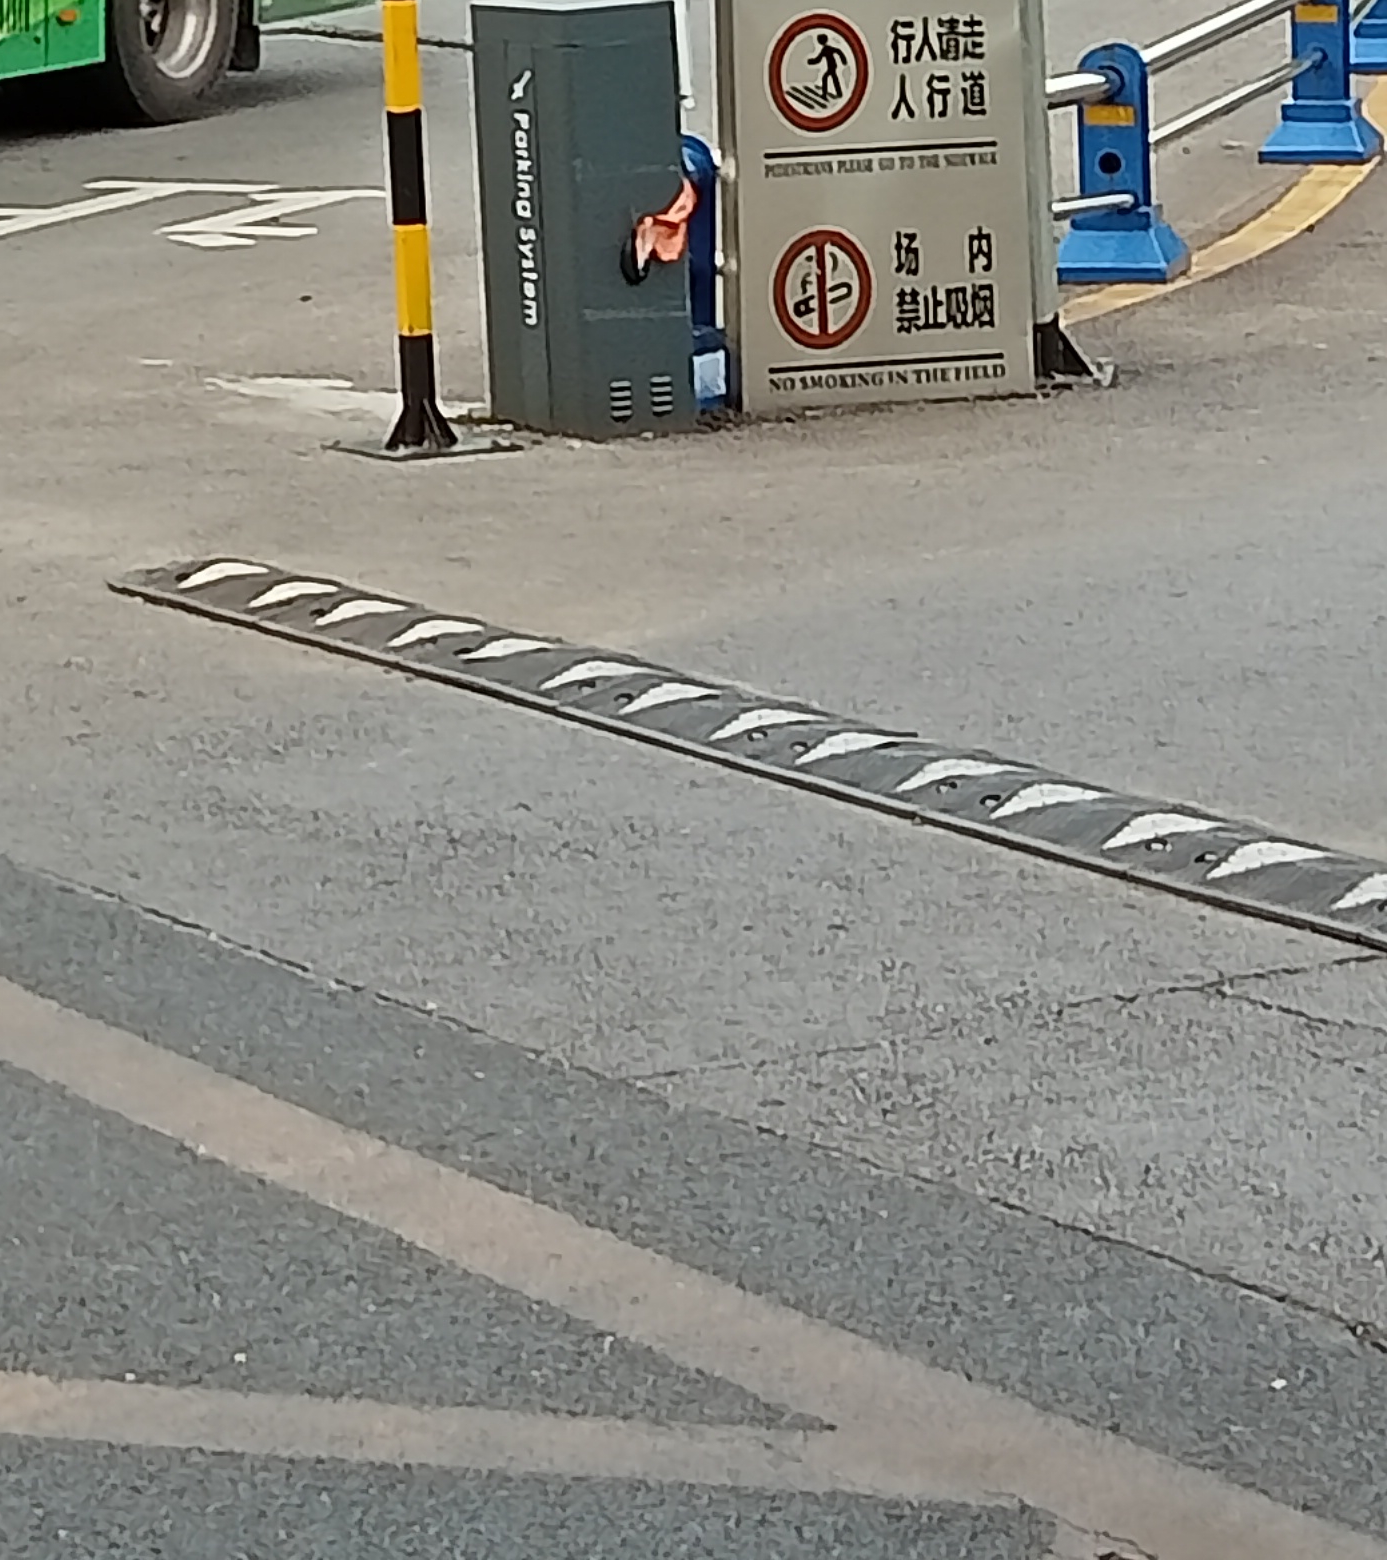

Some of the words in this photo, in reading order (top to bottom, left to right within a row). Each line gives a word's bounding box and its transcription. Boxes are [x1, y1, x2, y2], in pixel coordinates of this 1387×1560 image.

[889, 12, 987, 66] 行人请走
[890, 69, 988, 120] 人行道
[895, 283, 995, 334] 禁止吸烟
[768, 376, 796, 393] NO
[798, 370, 884, 391] SMOKING
[887, 368, 909, 386] IN
[912, 366, 951, 385] THE
[953, 362, 1007, 383] FIELD
